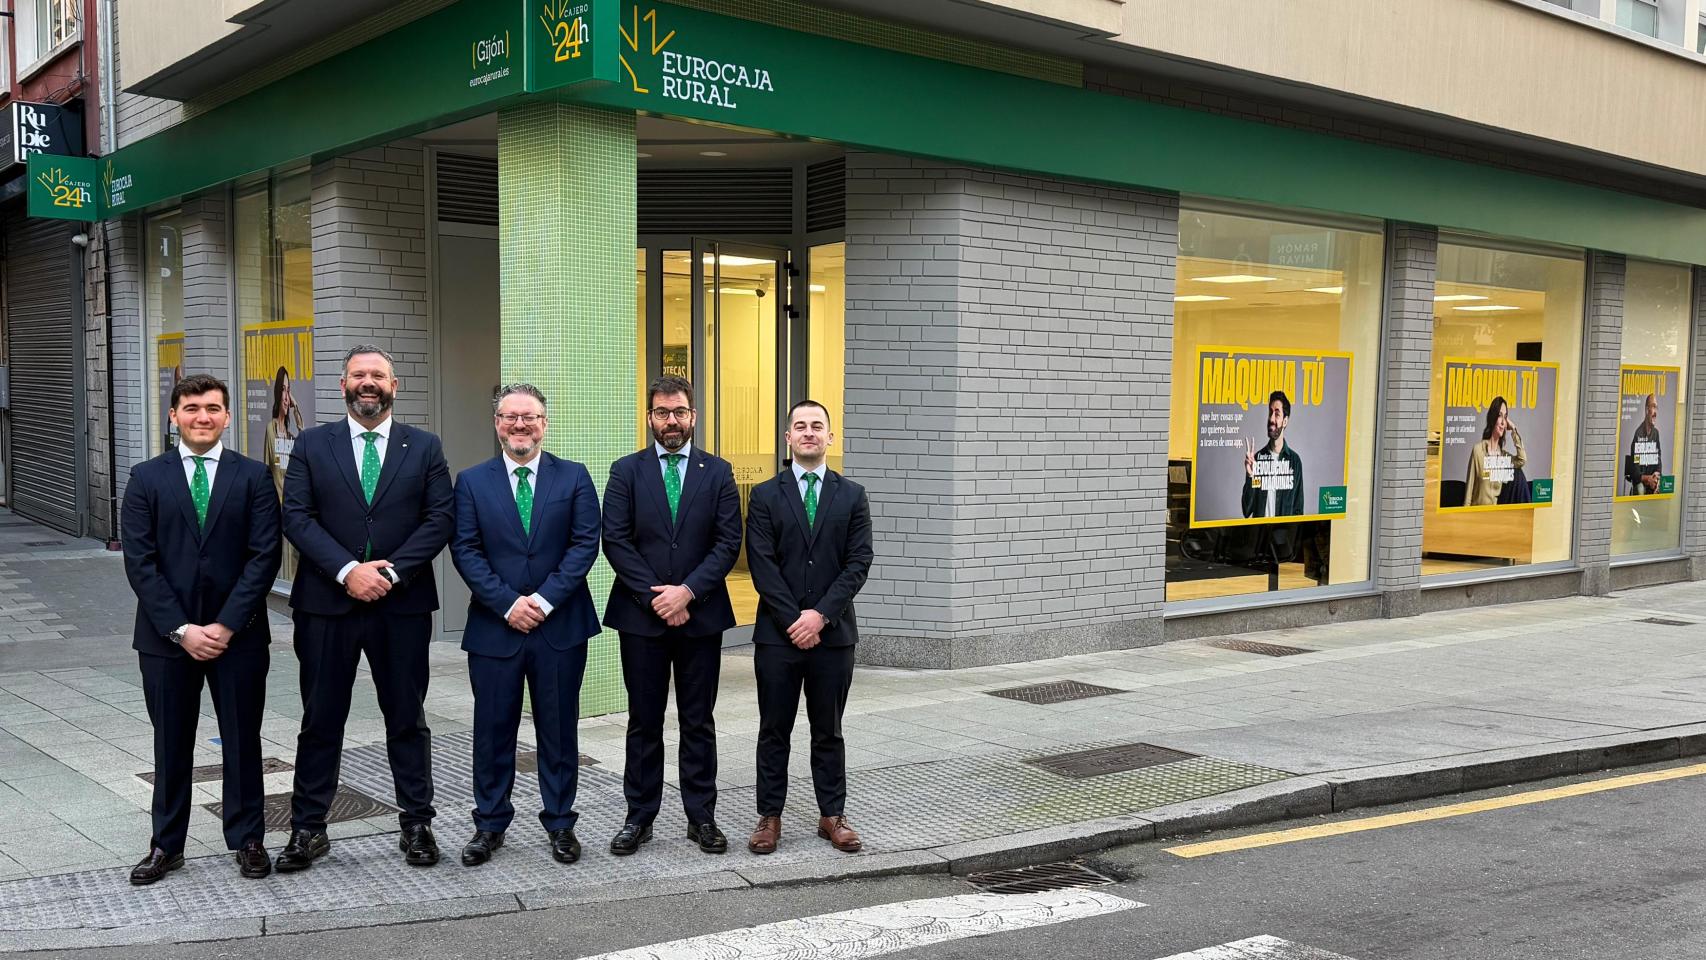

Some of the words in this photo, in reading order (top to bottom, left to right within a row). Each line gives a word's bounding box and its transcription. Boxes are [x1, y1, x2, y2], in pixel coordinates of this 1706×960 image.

[563, 4, 589, 18] CAJERO
[554, 16, 590, 63] 24h
[661, 51, 775, 93] EUROCAJA
[661, 76, 738, 109] RURAL
[20, 105, 46, 131] Ru
[21, 126, 51, 148] bie
[54, 185, 92, 208] 24h
[1201, 352, 1296, 412] MÁQUINA
[1302, 355, 1326, 407] TÚ
[1446, 362, 1517, 413] MÁQUINA
[1521, 366, 1539, 410] TÚ
